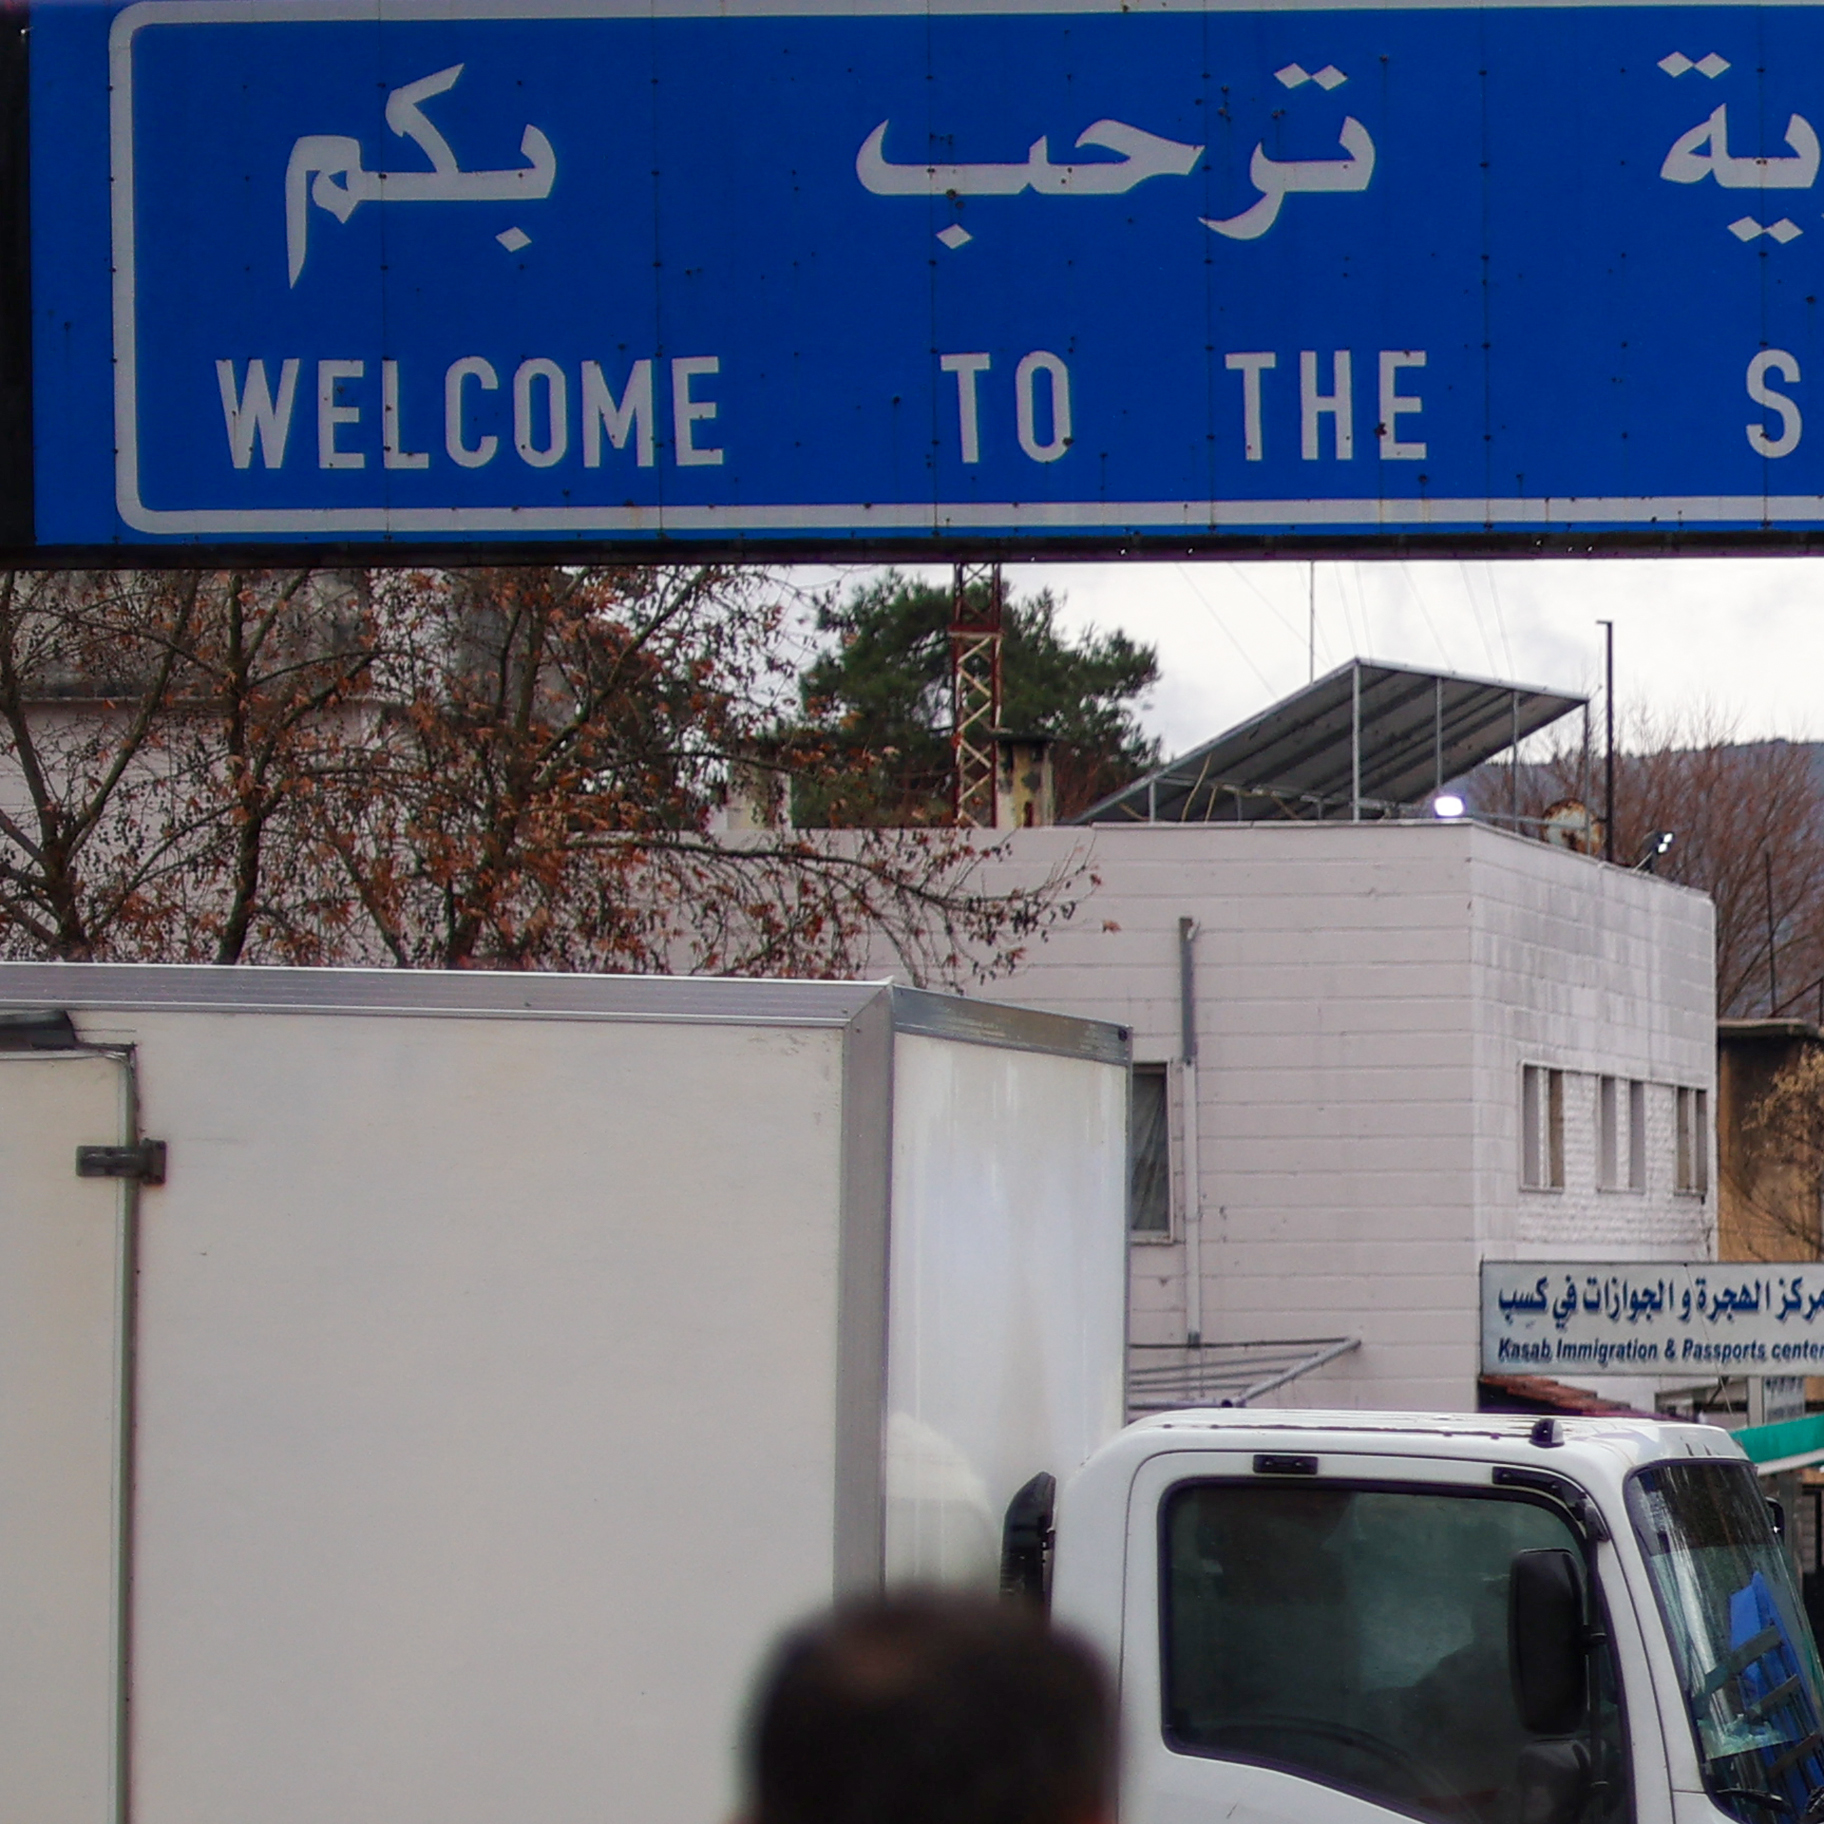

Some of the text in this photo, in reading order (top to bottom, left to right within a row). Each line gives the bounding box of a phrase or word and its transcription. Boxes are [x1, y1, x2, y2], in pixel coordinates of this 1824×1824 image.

[286, 63, 556, 287] بكم
[856, 63, 1376, 248] ترحب
[216, 355, 724, 470] WELCOME
[940, 350, 1072, 464] TO
[1225, 349, 1428, 461] THE
[1552, 1274, 1578, 1330] في
[1696, 1278, 1770, 1322] الهجرة
[1499, 1337, 1551, 1362] Kasab
[1556, 1337, 1658, 1366] Immigration
[1664, 1338, 1676, 1361] &
[1682, 1338, 1767, 1365] Passports
